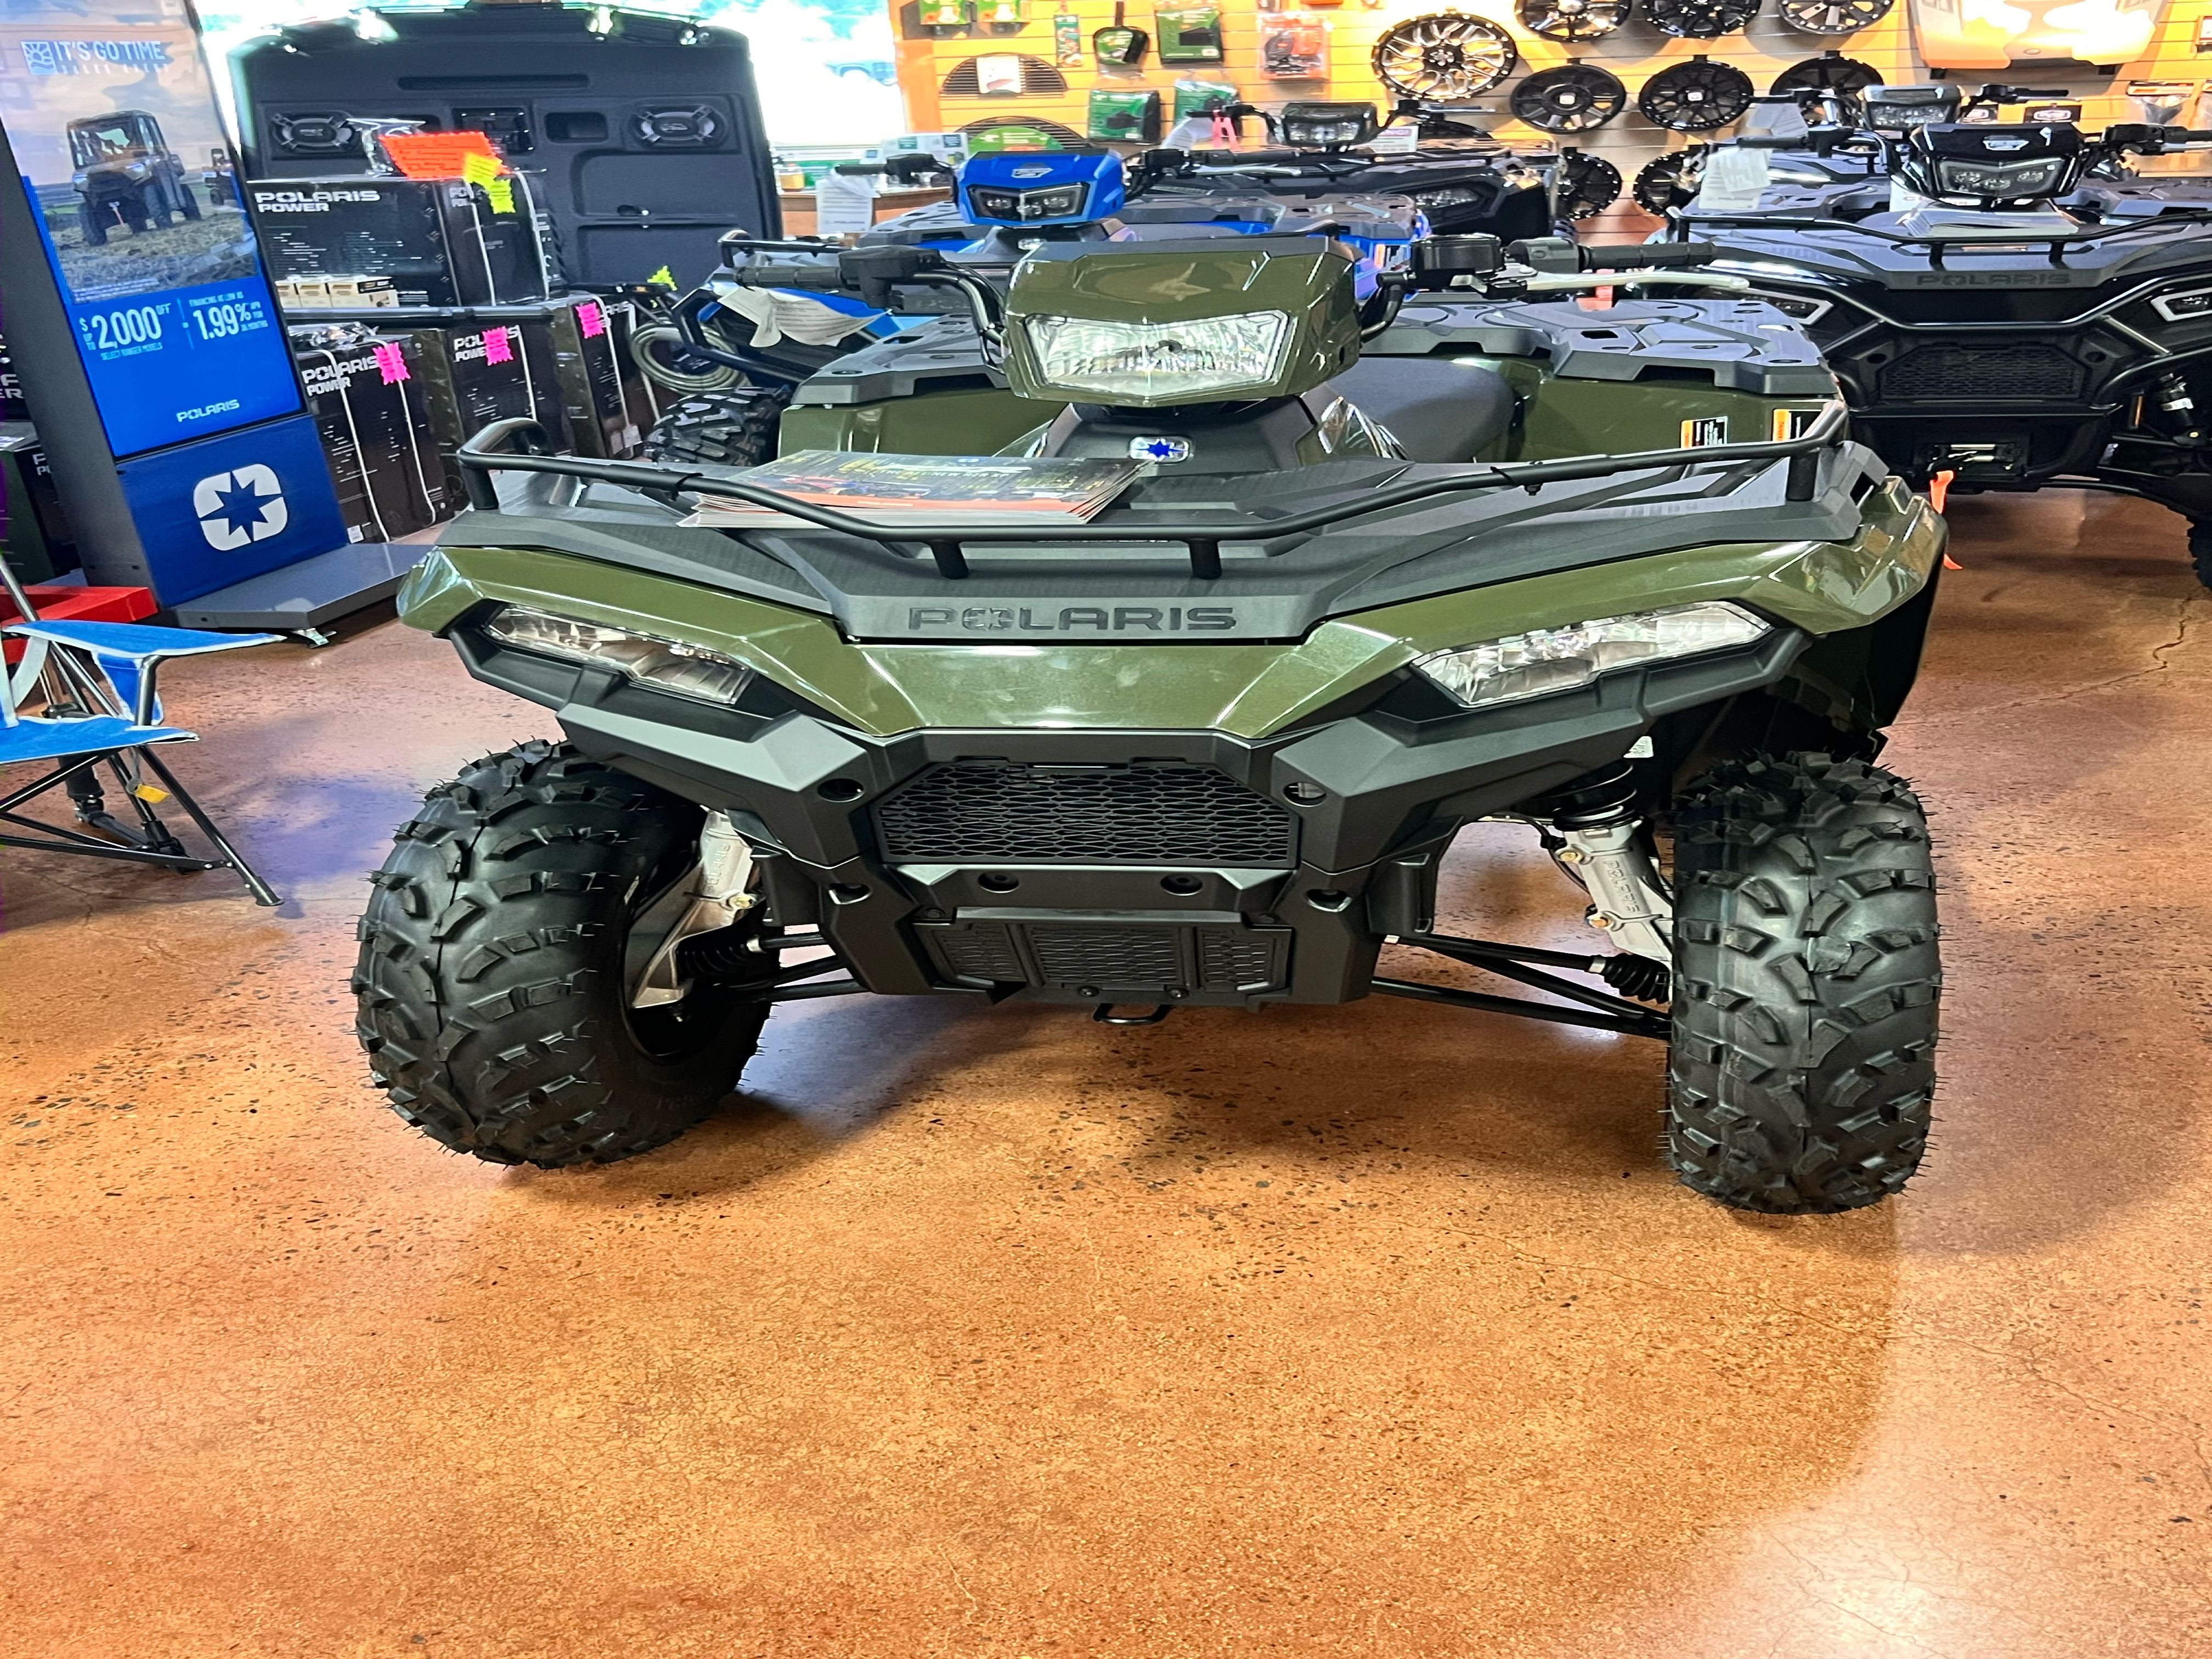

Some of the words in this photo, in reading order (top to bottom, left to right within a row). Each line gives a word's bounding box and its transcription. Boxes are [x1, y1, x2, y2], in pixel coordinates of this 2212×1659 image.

[53, 41, 91, 61] IT'S
[92, 41, 120, 61] GO
[120, 41, 165, 60] TIME
[254, 190, 381, 203] POLARIS
[258, 203, 330, 212] POWER
[1916, 274, 2070, 286] POLARIS
[193, 302, 252, 340] 1.99%
[454, 346, 488, 363] POWE
[302, 355, 380, 384] POLARIS
[176, 399, 240, 422] POLARIS
[908, 607, 1237, 631] POLARIS
